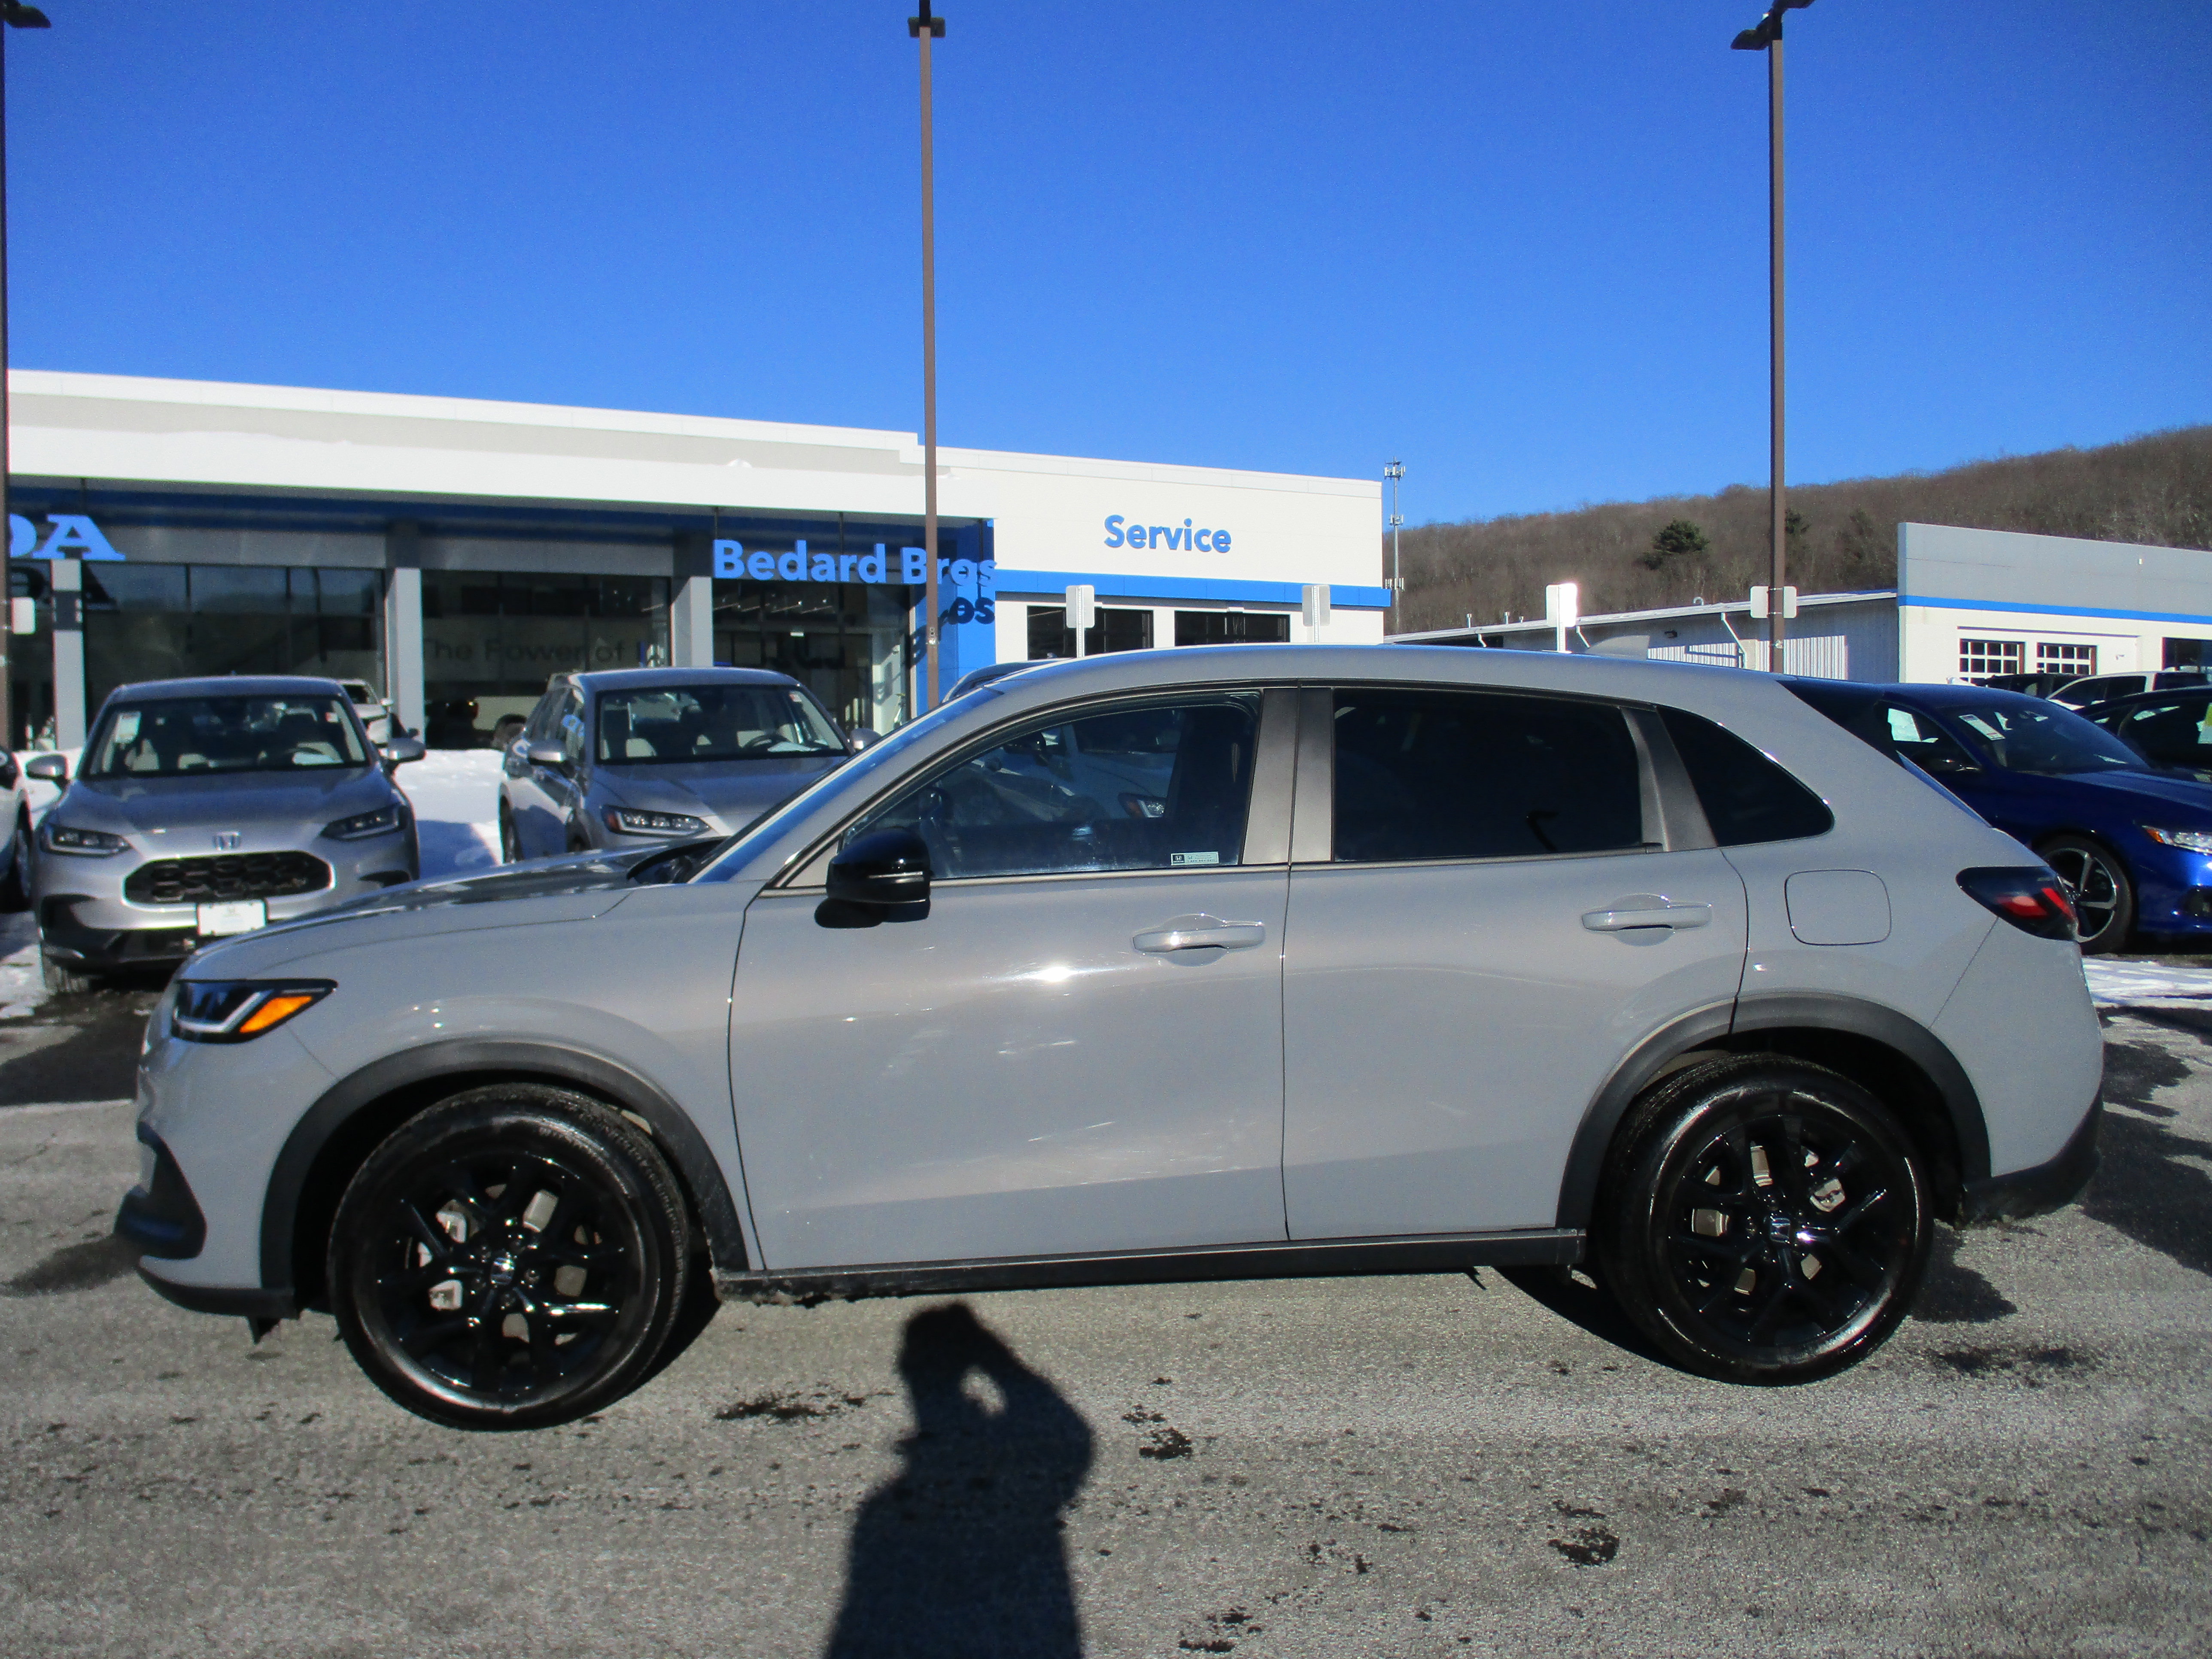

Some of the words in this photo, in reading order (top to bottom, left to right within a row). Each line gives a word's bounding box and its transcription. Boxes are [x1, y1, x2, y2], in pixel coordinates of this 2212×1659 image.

[1104, 514, 1232, 553] Service
[713, 539, 887, 583] Bedard
[901, 547, 998, 586] Bros
[485, 638, 586, 661] Power
[596, 640, 626, 662] of
